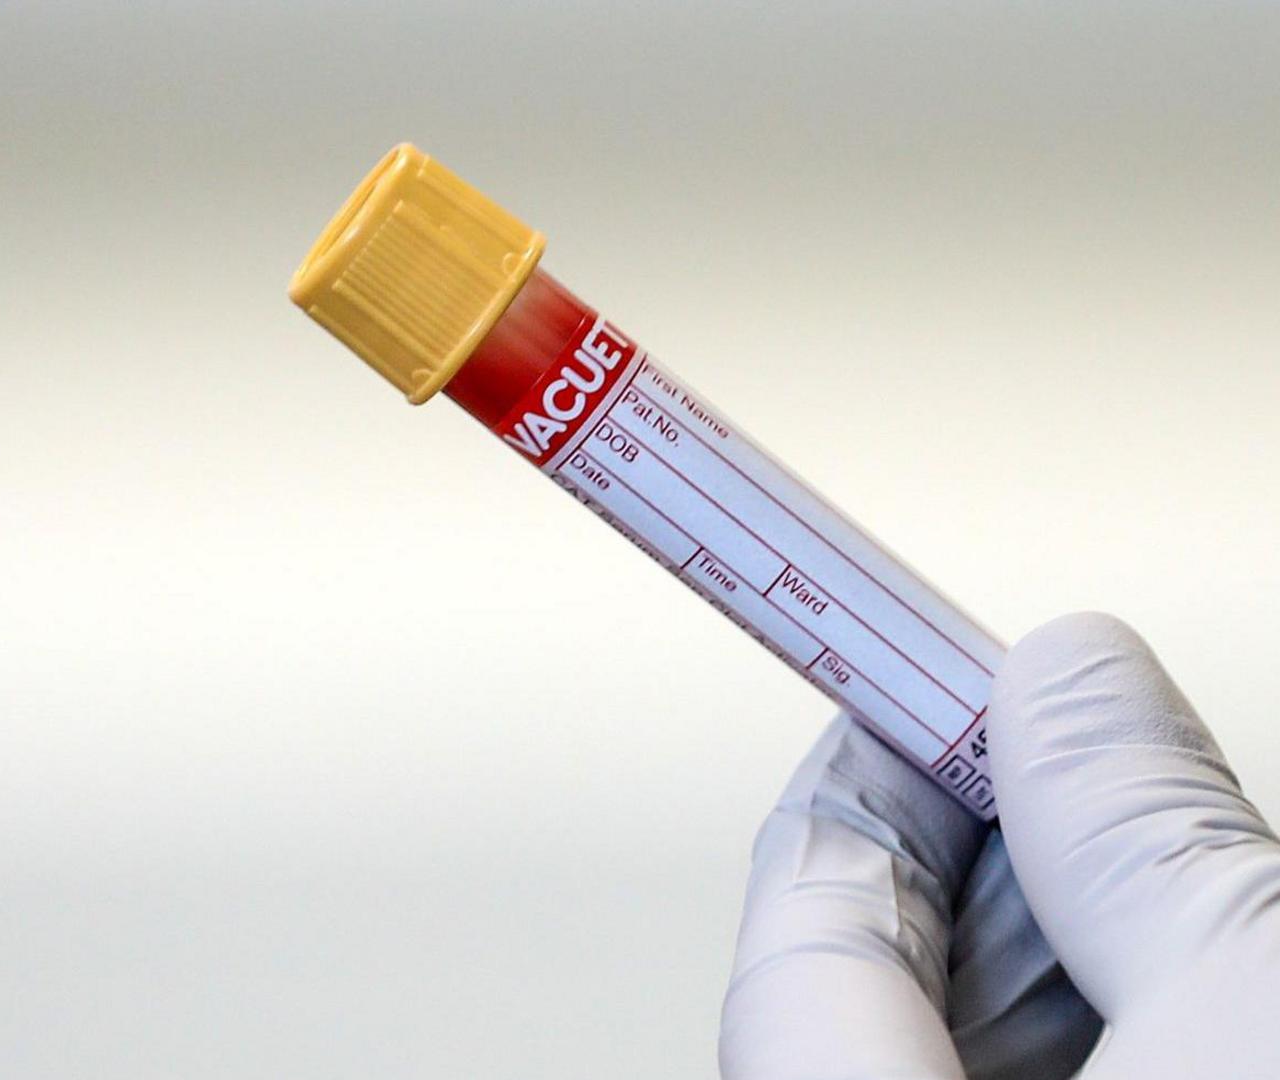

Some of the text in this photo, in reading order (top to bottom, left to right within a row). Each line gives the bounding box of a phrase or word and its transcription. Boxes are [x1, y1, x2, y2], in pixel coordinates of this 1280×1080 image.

[643, 363, 730, 439] First Name
[595, 423, 640, 463] DOB
[570, 453, 611, 491] Date
[698, 556, 738, 592] Time
[782, 571, 829, 615] Ward
[822, 656, 851, 687] Sig.
